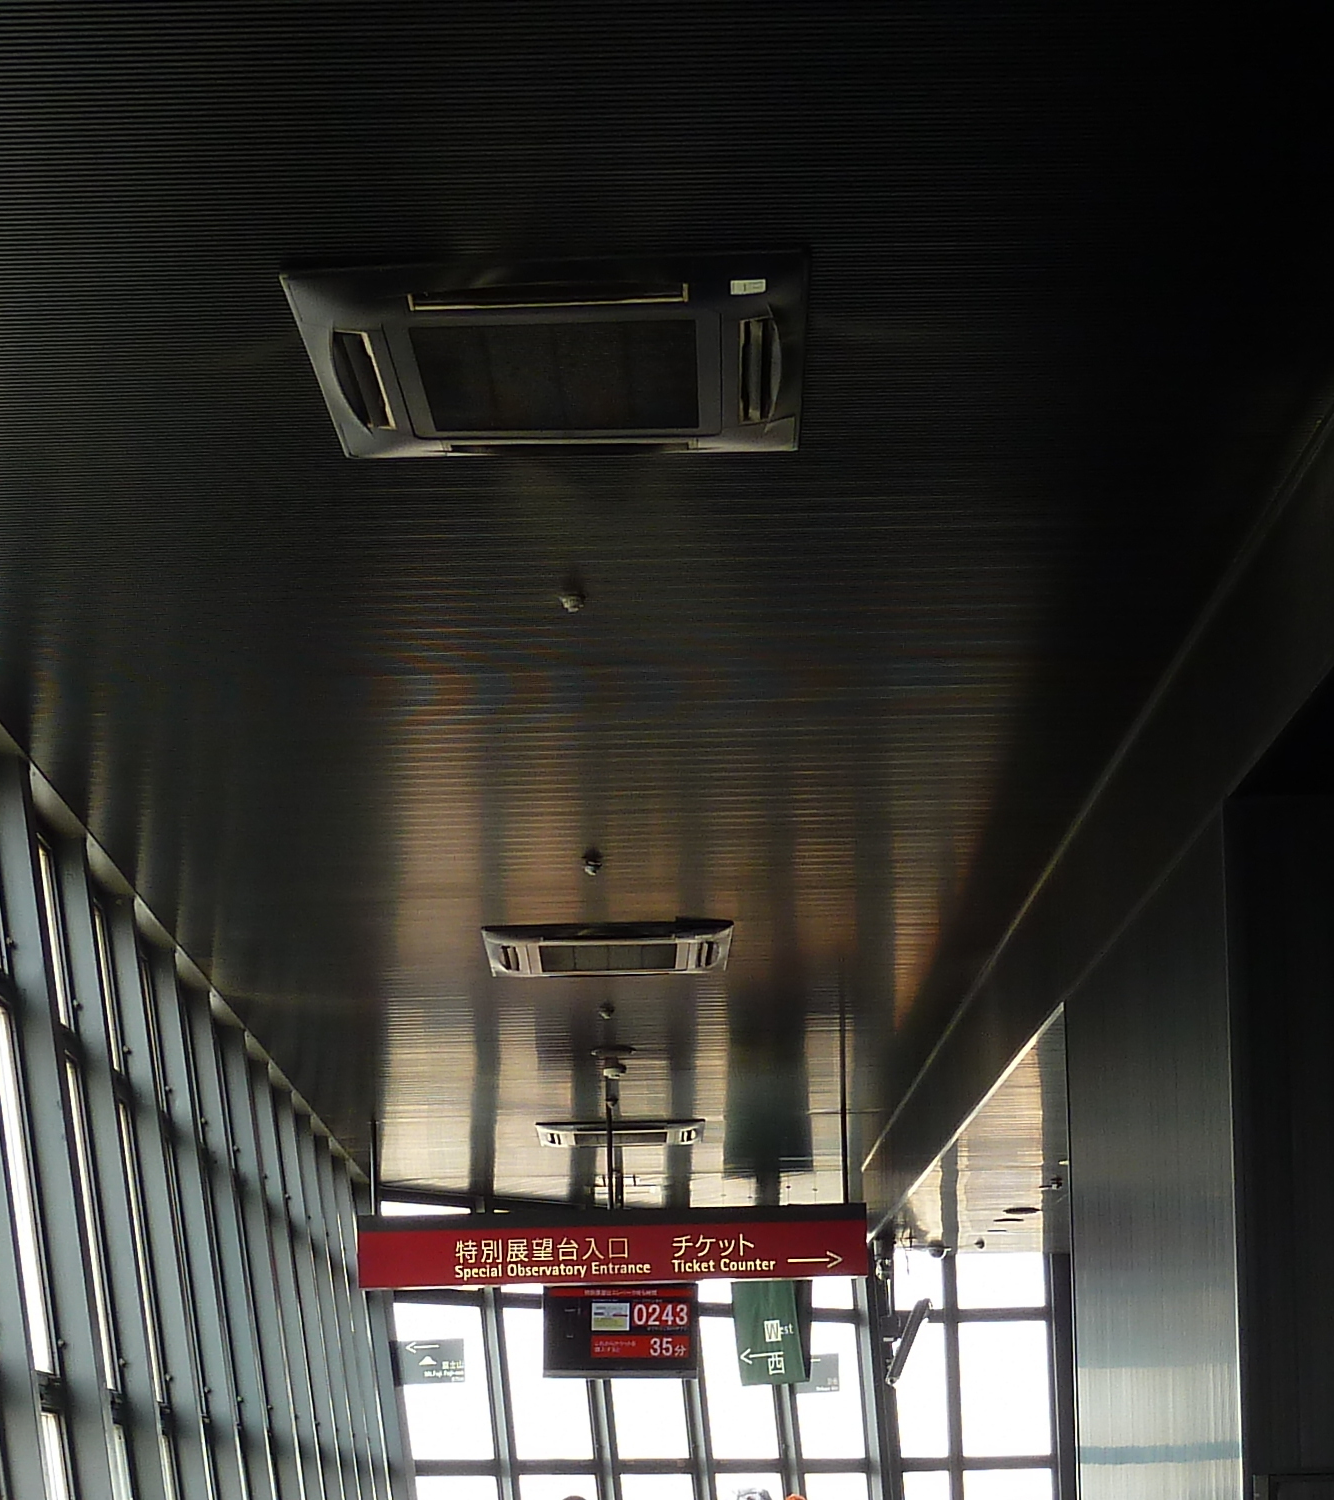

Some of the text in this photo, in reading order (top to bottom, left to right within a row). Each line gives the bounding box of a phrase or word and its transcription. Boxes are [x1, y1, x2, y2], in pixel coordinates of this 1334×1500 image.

[455, 1237, 629, 1264] 特別展望台入口
[671, 1233, 755, 1257] チケット
[454, 1261, 652, 1281] Special Observatory Entrance
[671, 1258, 776, 1273] Ticket Counter
[633, 1303, 689, 1326] 0243
[764, 1320, 794, 1342] West
[649, 1337, 687, 1357] 35分
[767, 1352, 786, 1376] 西
